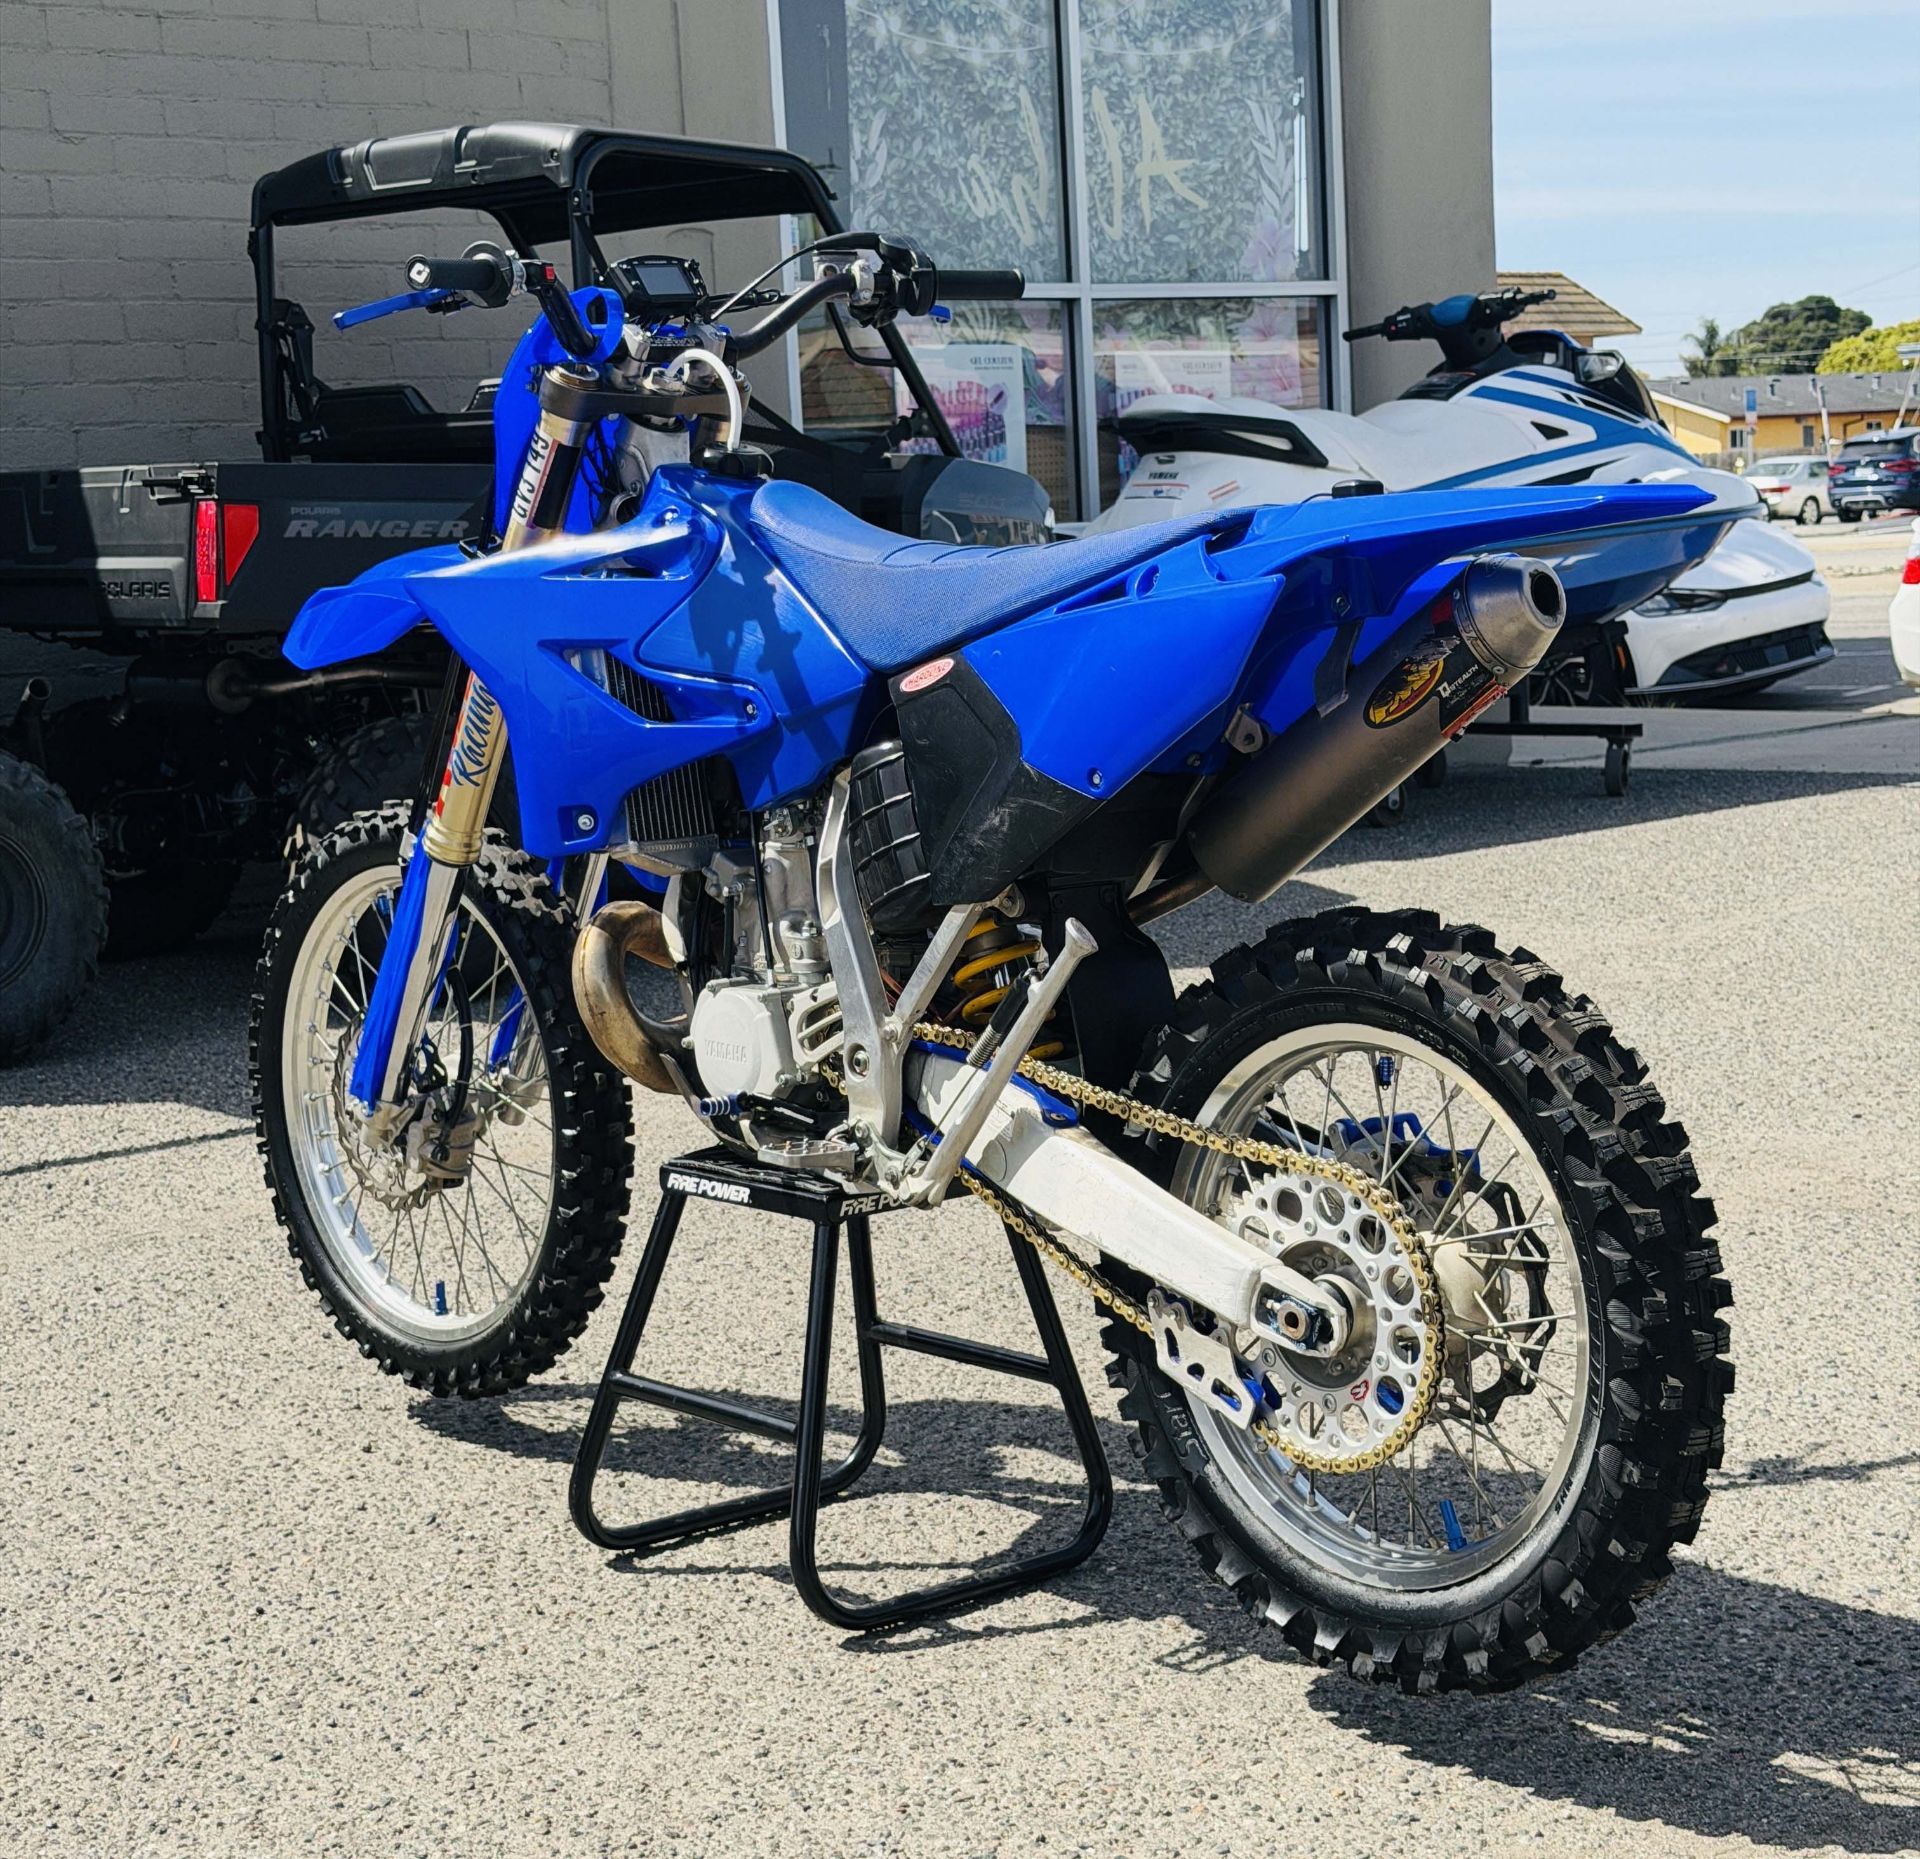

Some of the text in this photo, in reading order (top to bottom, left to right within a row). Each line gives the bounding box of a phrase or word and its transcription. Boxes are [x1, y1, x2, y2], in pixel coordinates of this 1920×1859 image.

[290, 506, 342, 516] POLARIS
[283, 519, 470, 538] RANGER
[667, 1172, 751, 1203] FIRE POWER
[840, 1195, 880, 1217] FIRE
